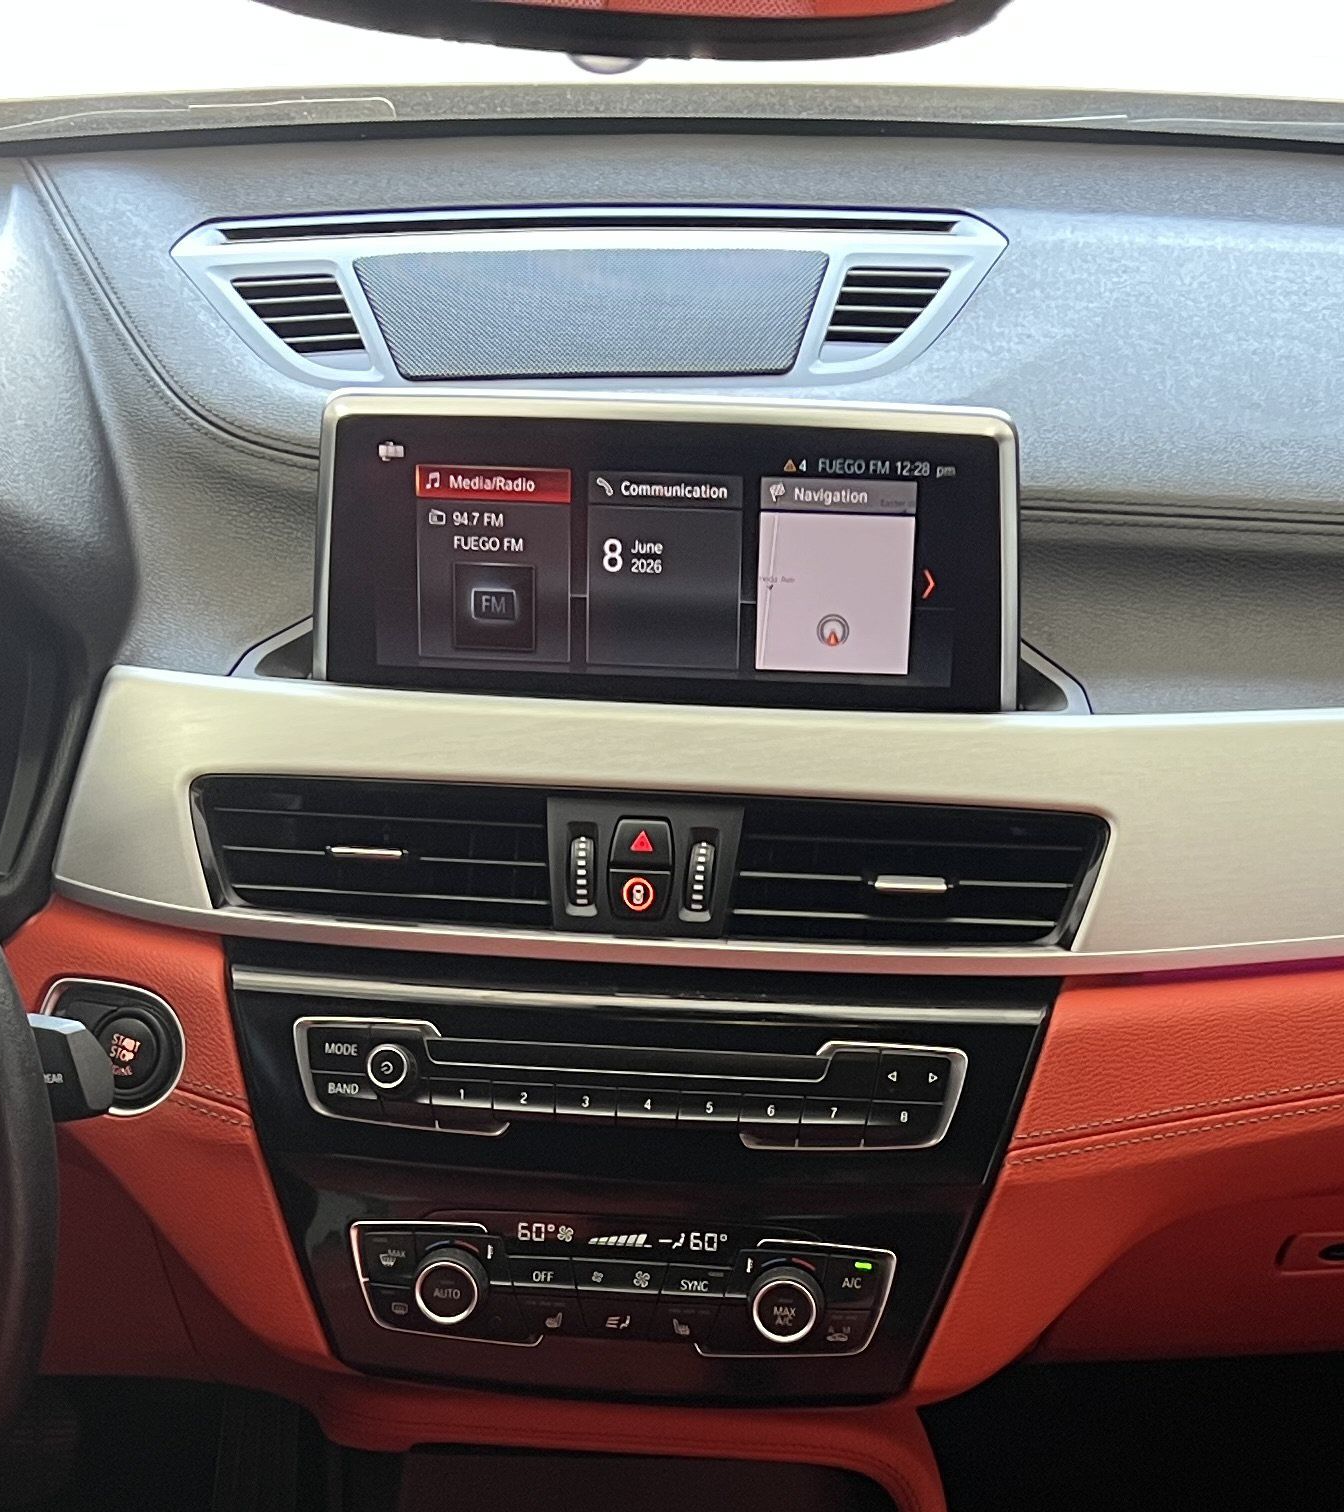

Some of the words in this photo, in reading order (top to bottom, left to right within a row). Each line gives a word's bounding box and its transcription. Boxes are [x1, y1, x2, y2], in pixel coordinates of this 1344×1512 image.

[798, 459, 807, 472] 4
[818, 458, 865, 474] FUEGO
[869, 461, 890, 475] FM
[896, 461, 930, 476] 12:28
[936, 466, 956, 479] pm
[449, 474, 536, 492] Media/Radio
[621, 481, 728, 500] Communication
[794, 487, 868, 505] Navigation
[452, 512, 479, 526] 94.7
[483, 513, 504, 527] FM
[453, 536, 499, 551] FUEGO
[503, 537, 524, 552] FM
[630, 540, 663, 555] June
[602, 537, 623, 573] 8
[631, 559, 662, 575] 2026
[481, 596, 506, 614] FM
[325, 1042, 358, 1056] MODE
[327, 1082, 359, 1095] BAND
[459, 1088, 465, 1100] 1
[519, 1092, 528, 1104] 2
[581, 1095, 590, 1109] 3
[644, 1098, 651, 1110] 4
[705, 1101, 714, 1113] 5
[767, 1105, 775, 1117] 6
[830, 1107, 838, 1119] 7
[900, 1111, 908, 1123] 8
[388, 1249, 406, 1258] MAX
[532, 1270, 554, 1283] OFF
[841, 1277, 862, 1289] A/C
[680, 1279, 709, 1292] SYNC
[433, 1288, 461, 1300] AUTO
[773, 1306, 796, 1317] MAX
[775, 1316, 792, 1327] A/C
